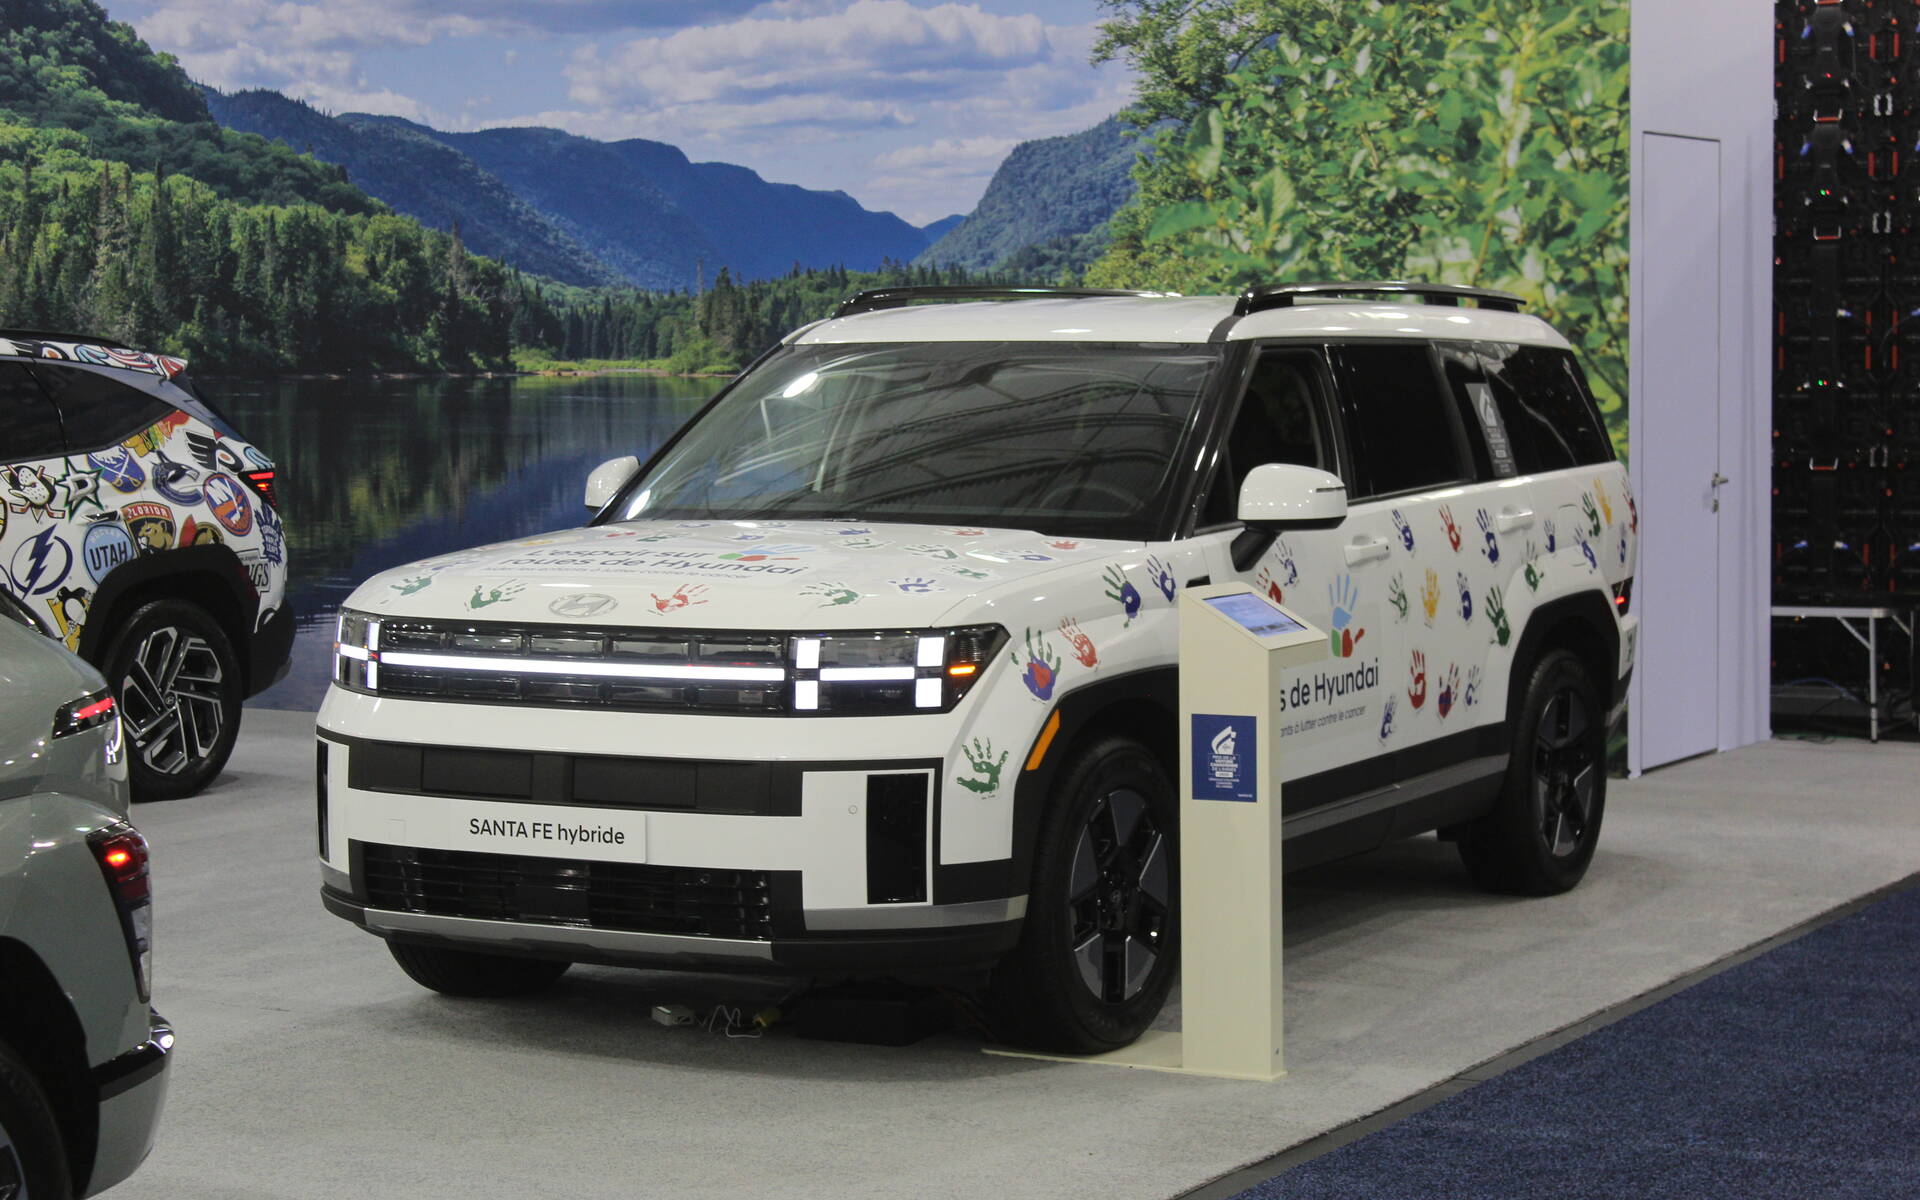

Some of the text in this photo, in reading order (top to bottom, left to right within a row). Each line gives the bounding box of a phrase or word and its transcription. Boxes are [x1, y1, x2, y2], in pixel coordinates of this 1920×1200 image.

[127, 505, 168, 518] FLORIDA
[89, 540, 128, 571] UTAH
[655, 550, 714, 558] sur
[600, 558, 645, 566] de
[651, 559, 808, 574] Hyundai
[1290, 678, 1310, 709] de
[1315, 657, 1379, 706] Hyundai
[1317, 713, 1338, 727] contre
[1345, 705, 1366, 719] cancer
[469, 818, 625, 845] SANTA FE hybride
